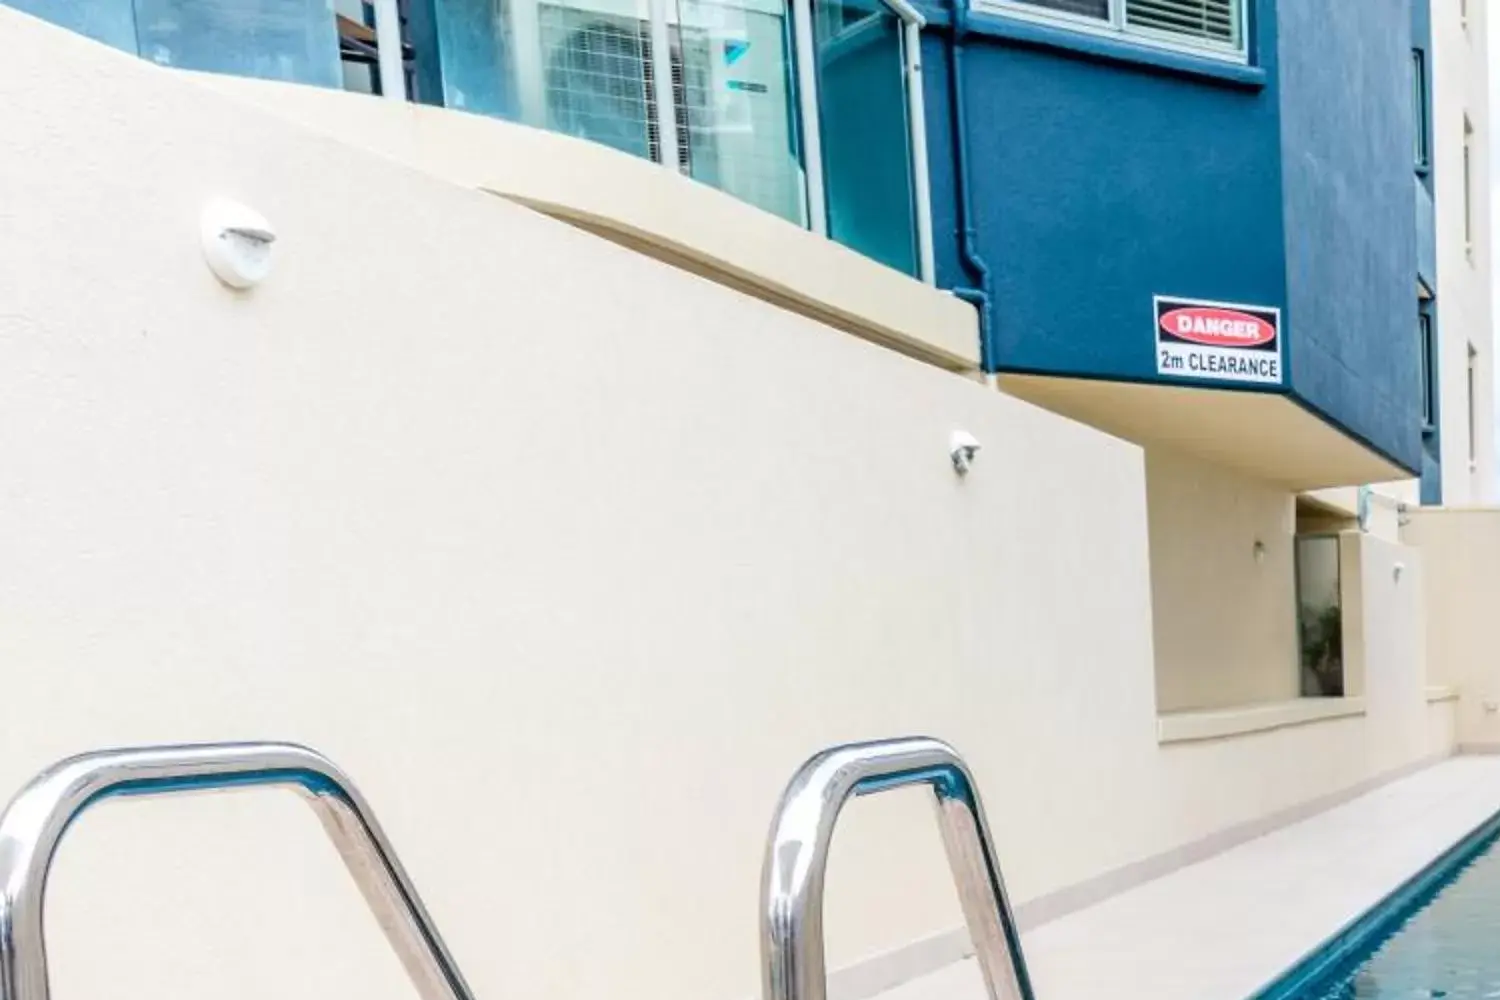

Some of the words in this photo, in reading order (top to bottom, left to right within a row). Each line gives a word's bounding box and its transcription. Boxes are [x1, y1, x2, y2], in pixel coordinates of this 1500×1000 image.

[1177, 315, 1260, 339] DANGER
[1161, 351, 1184, 369] 2m
[1189, 353, 1278, 377] CLEARANCE
